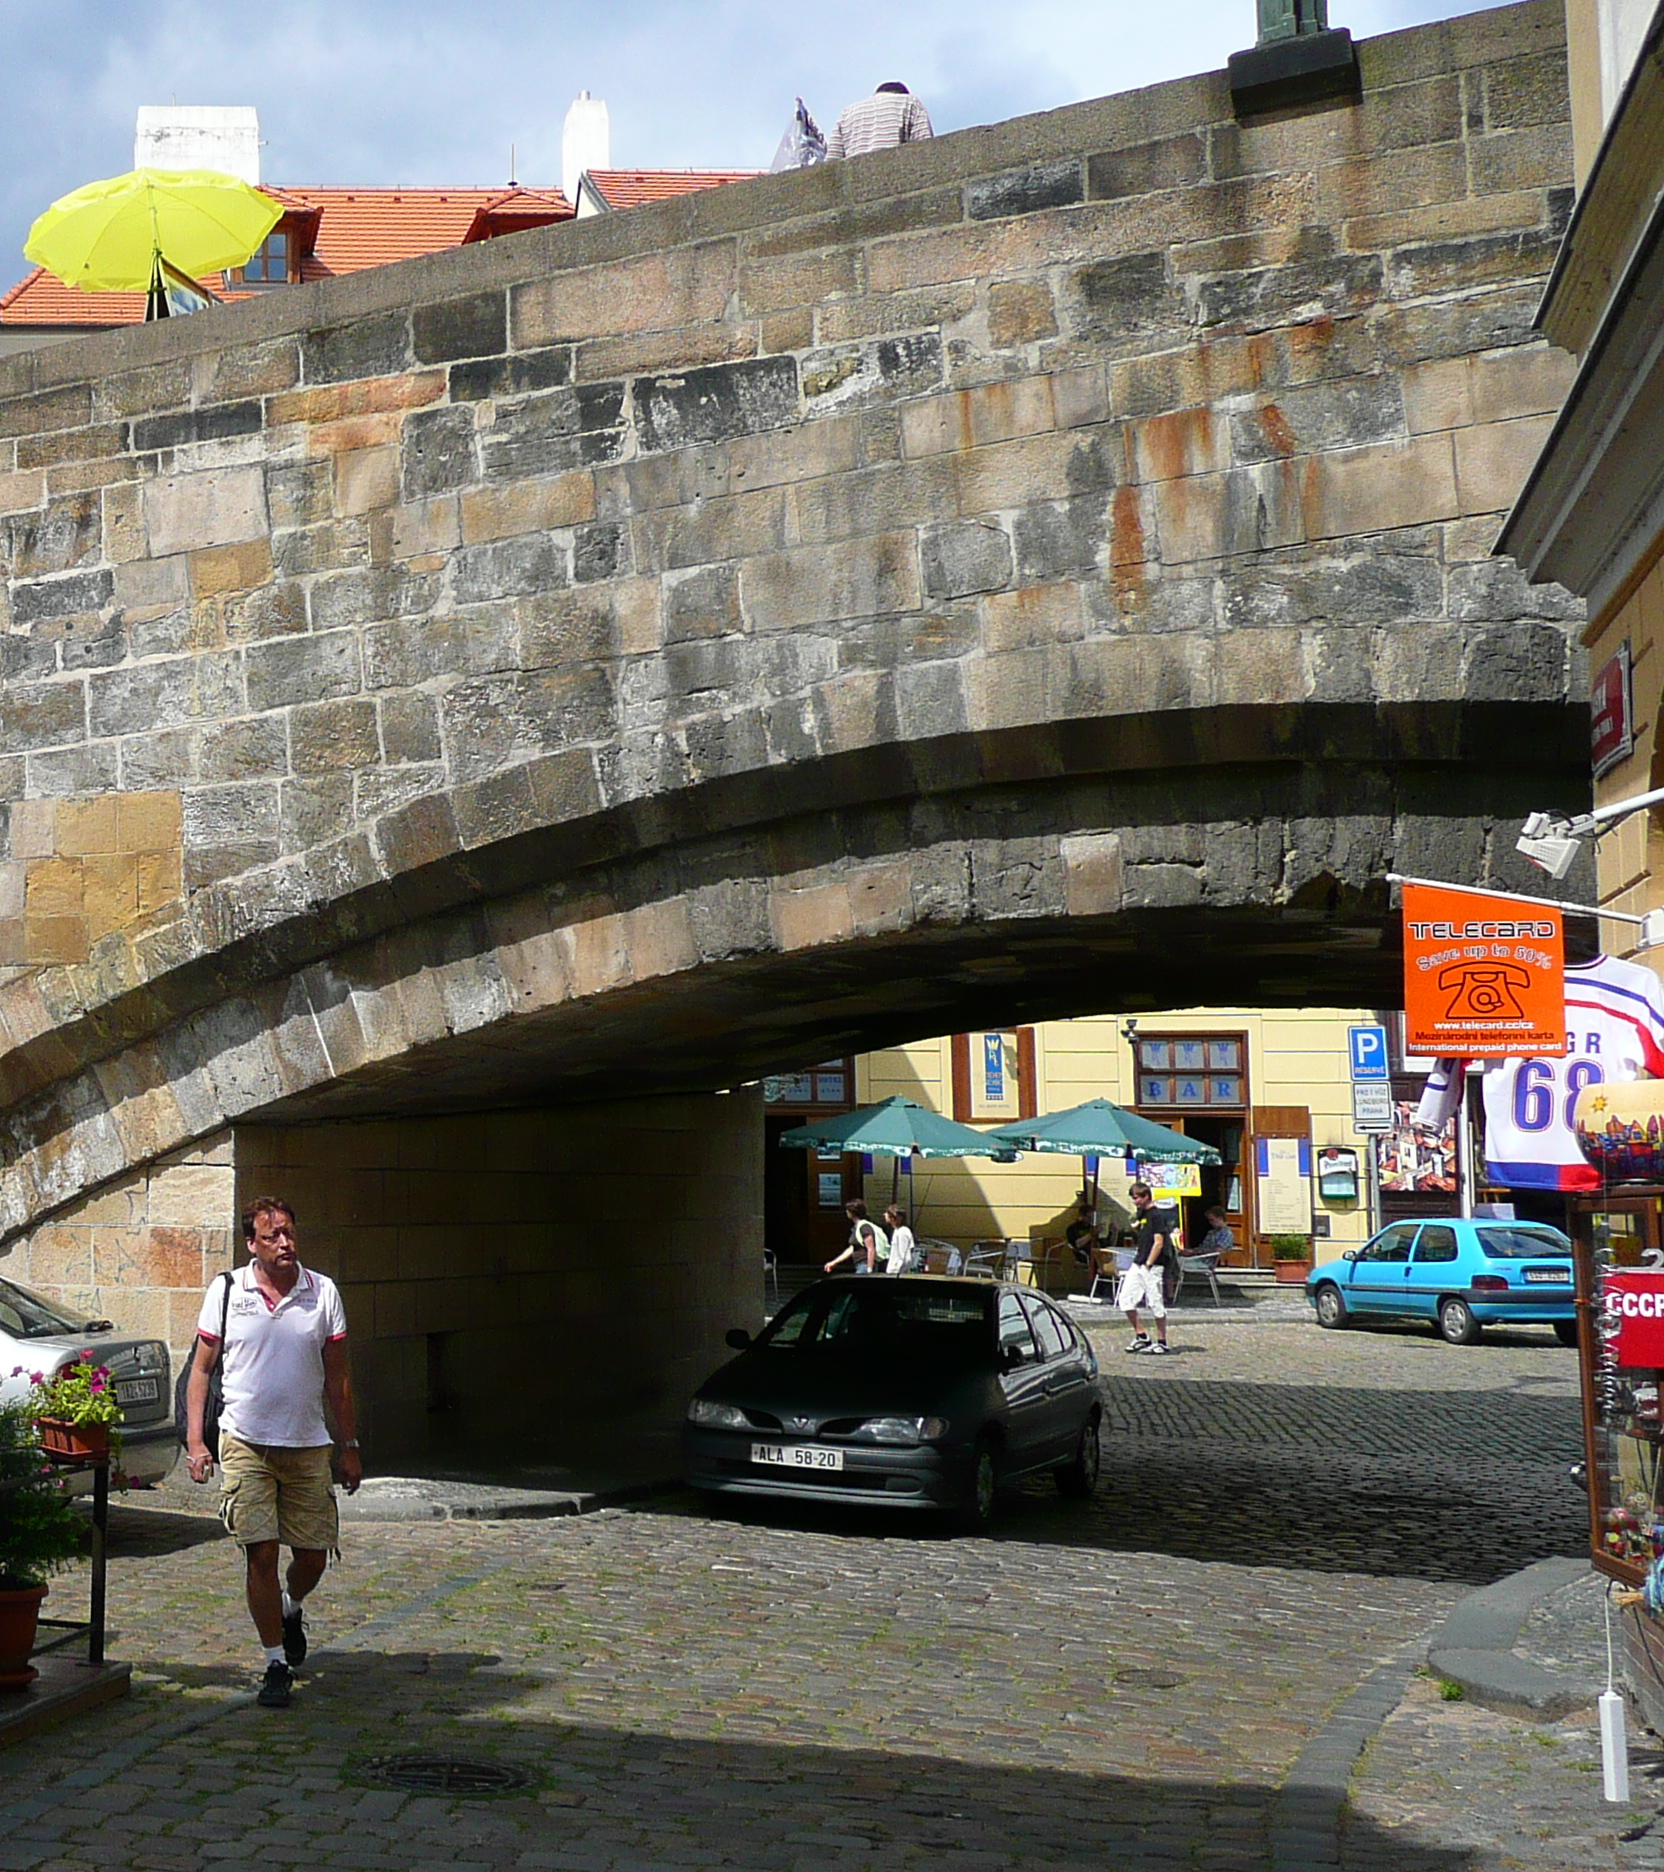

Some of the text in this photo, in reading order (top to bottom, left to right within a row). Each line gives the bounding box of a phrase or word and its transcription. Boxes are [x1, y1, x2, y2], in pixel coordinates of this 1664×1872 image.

[1416, 943, 1552, 971] Save up to 50%
[1528, 1031, 1554, 1040] karta
[1357, 1033, 1378, 1063] P
[1409, 1042, 1562, 1053] International prepaid phone card
[759, 1446, 836, 1467] ALA 58-20
